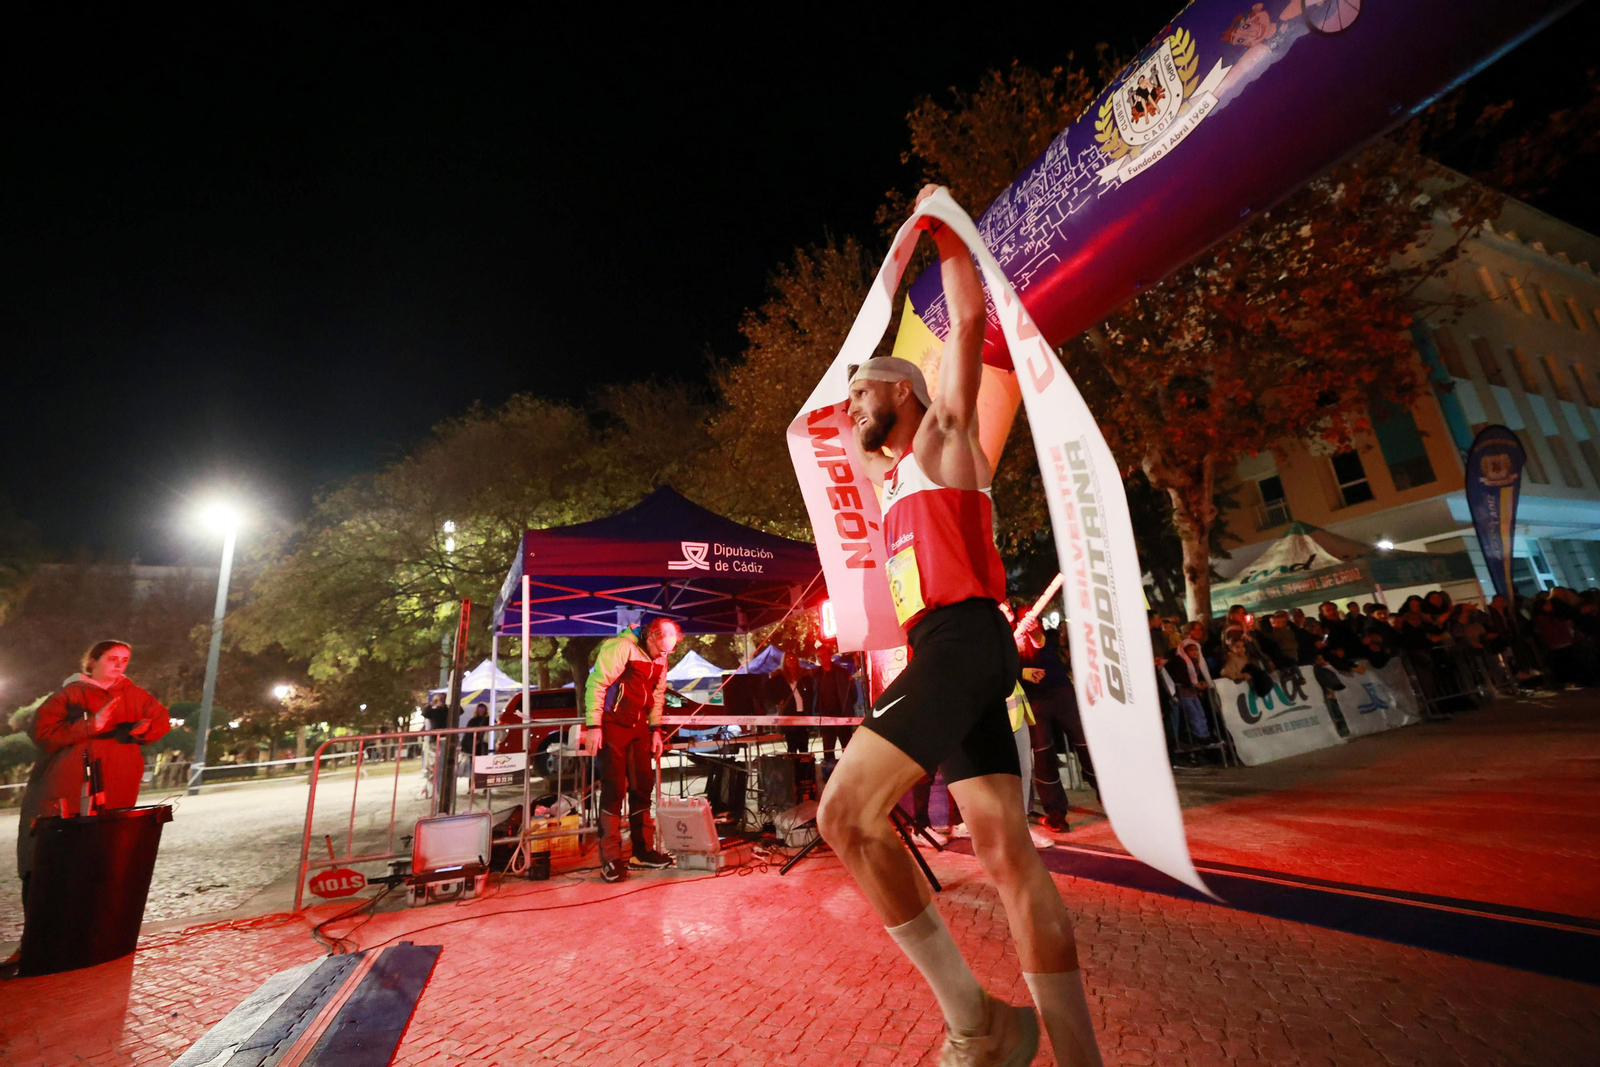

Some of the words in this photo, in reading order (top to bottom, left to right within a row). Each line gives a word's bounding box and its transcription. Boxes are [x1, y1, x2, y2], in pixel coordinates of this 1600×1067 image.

[1164, 54, 1176, 82] OLIMPO
[1115, 99, 1121, 110] DE
[1117, 110, 1128, 132] CLUB
[1143, 111, 1174, 141] CADIZ
[1127, 149, 1162, 175] Fundado
[1162, 143, 1168, 151] 1
[1169, 125, 1189, 146] Abril
[1189, 101, 1210, 124] 1968
[1049, 445, 1092, 611] SILVESTRE
[713, 543, 774, 559] Diputación
[714, 560, 729, 571] de
[732, 560, 764, 574] Cádiz
[1064, 440, 1126, 705] GADITANA
[1083, 620, 1104, 707] SAN
